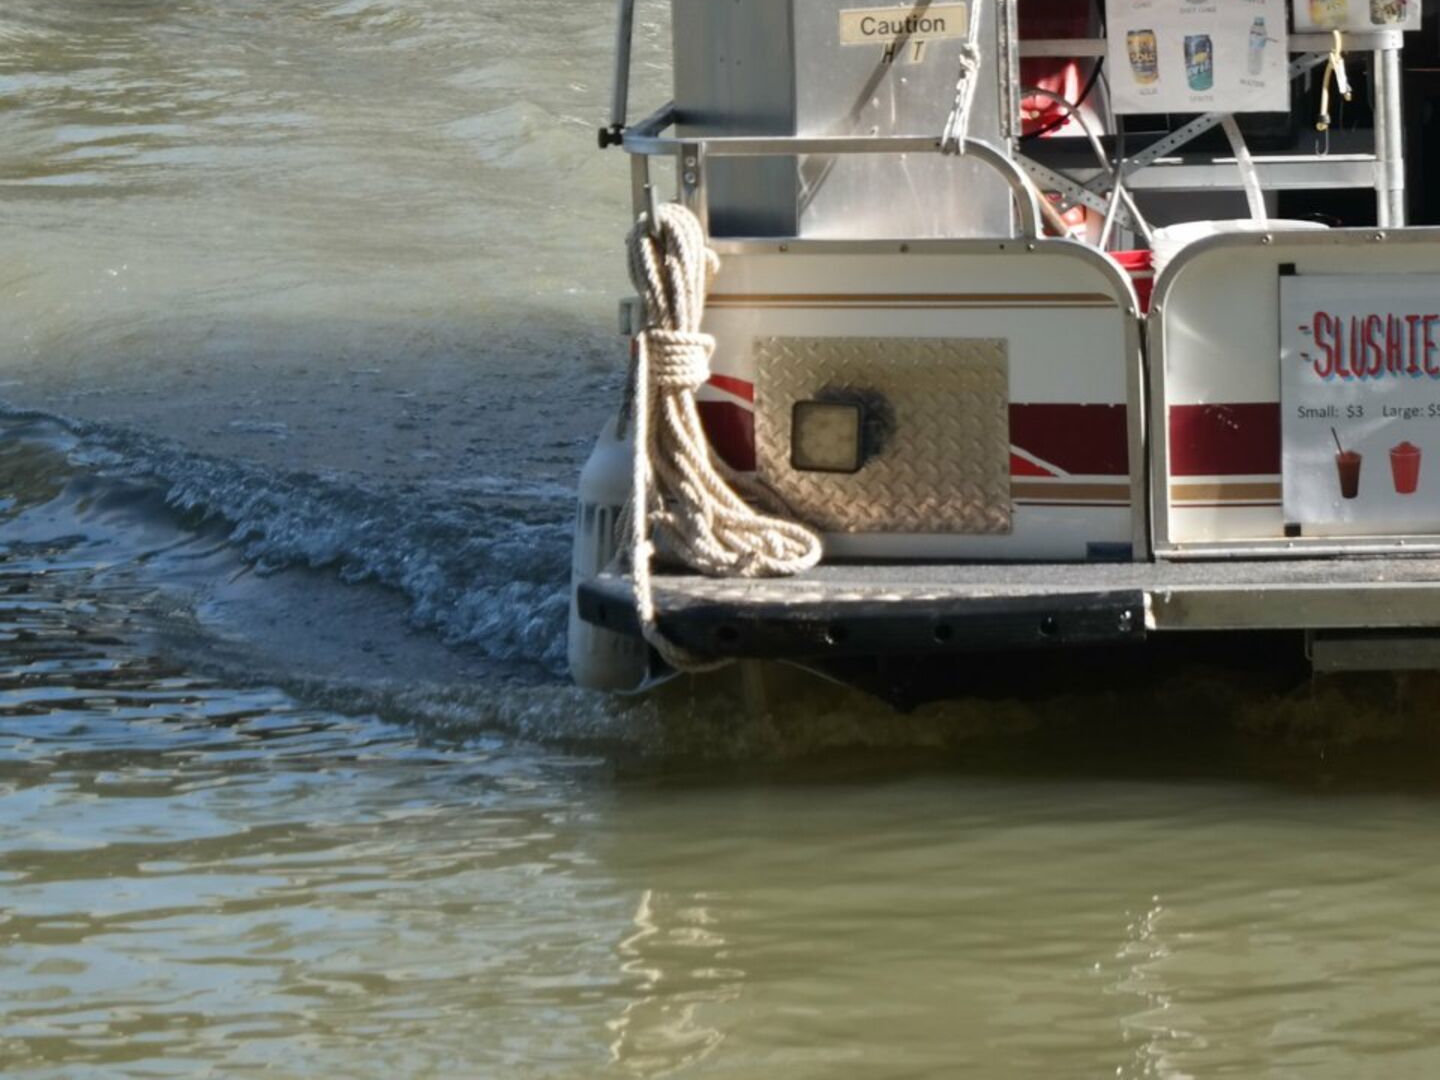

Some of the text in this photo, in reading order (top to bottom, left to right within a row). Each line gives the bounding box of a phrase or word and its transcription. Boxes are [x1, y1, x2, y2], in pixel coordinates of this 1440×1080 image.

[860, 15, 946, 36] Caution
[882, 41, 924, 63] H T
[1297, 405, 1364, 418] Small: $3
[1382, 405, 1425, 421] Large:
